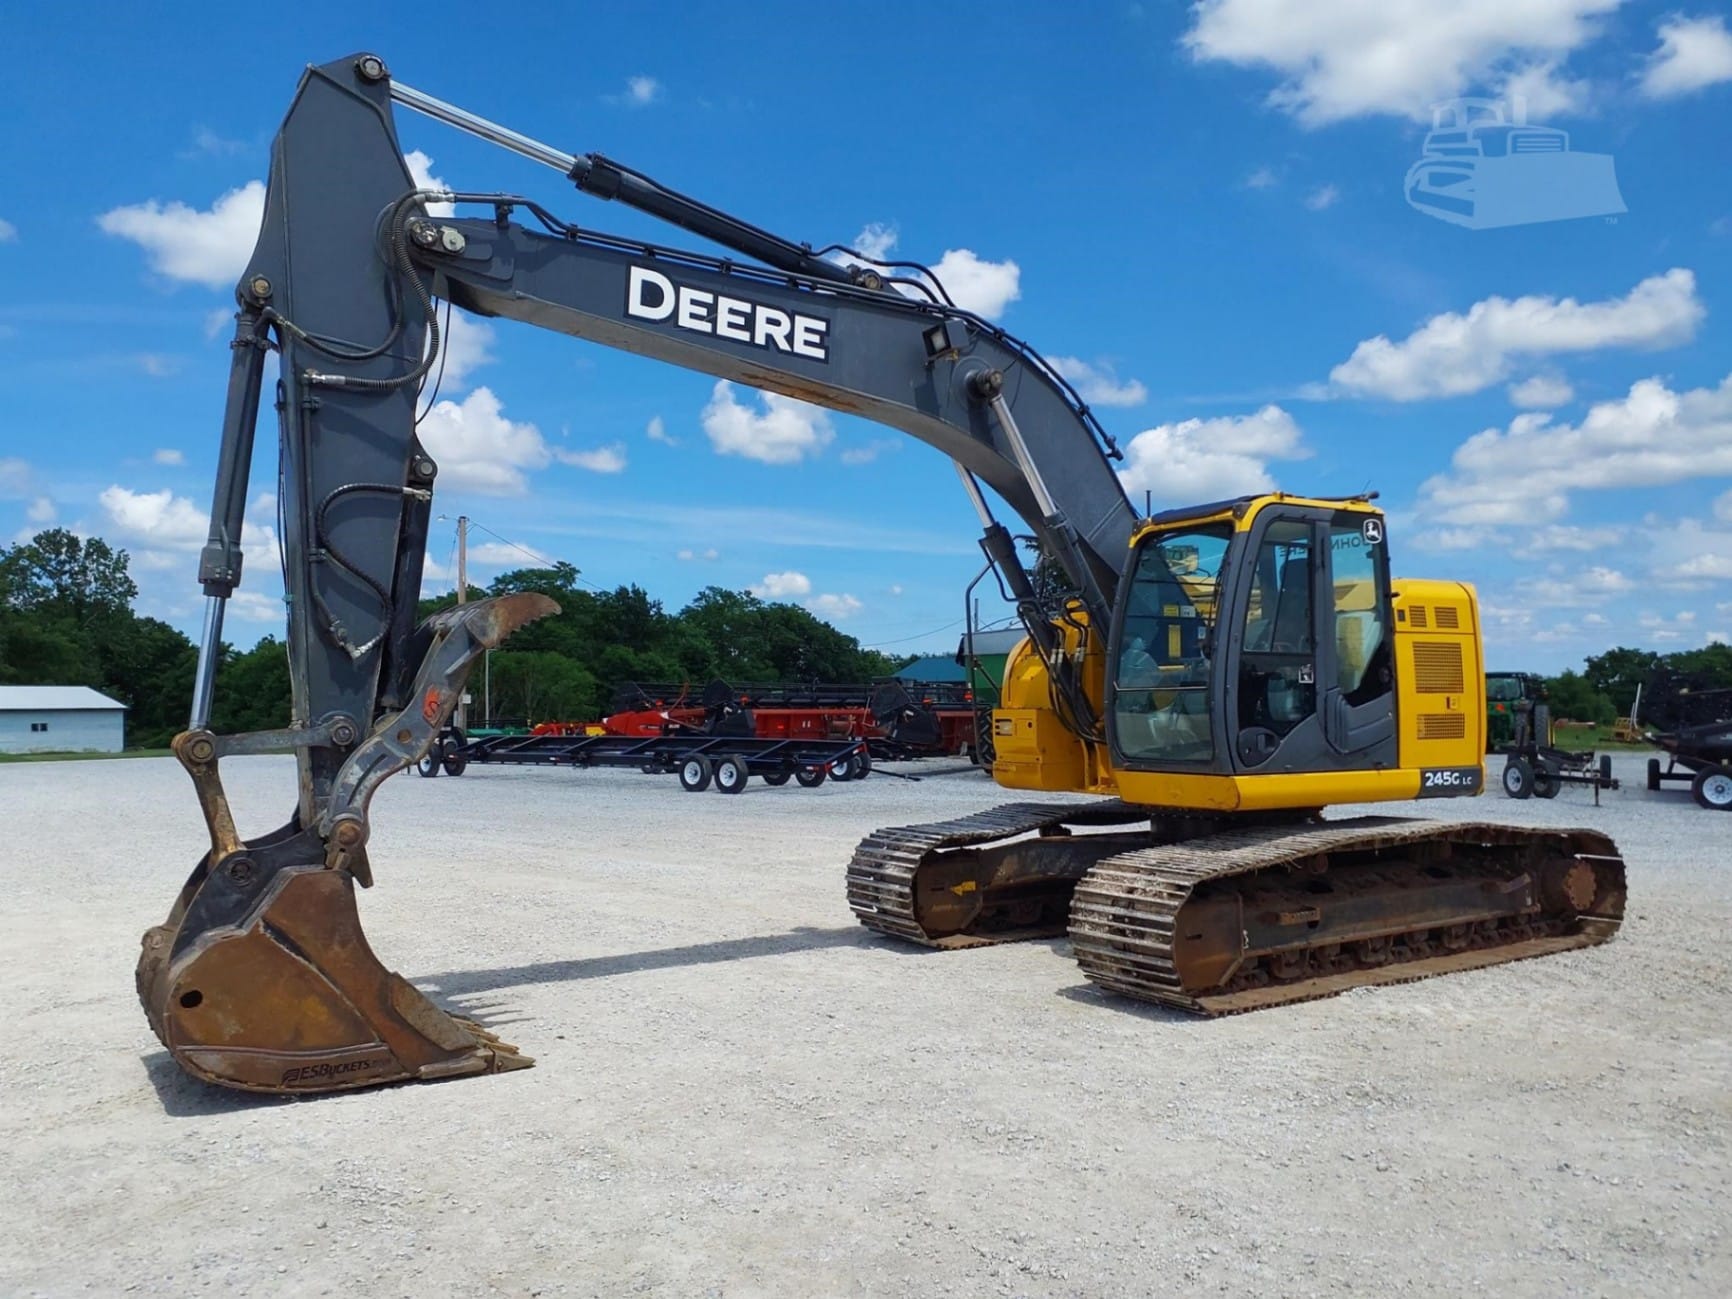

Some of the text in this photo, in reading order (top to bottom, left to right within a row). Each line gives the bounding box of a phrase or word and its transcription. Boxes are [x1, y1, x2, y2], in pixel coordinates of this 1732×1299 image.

[628, 265, 827, 359] DEERE
[1425, 771, 1472, 787] 245G LC
